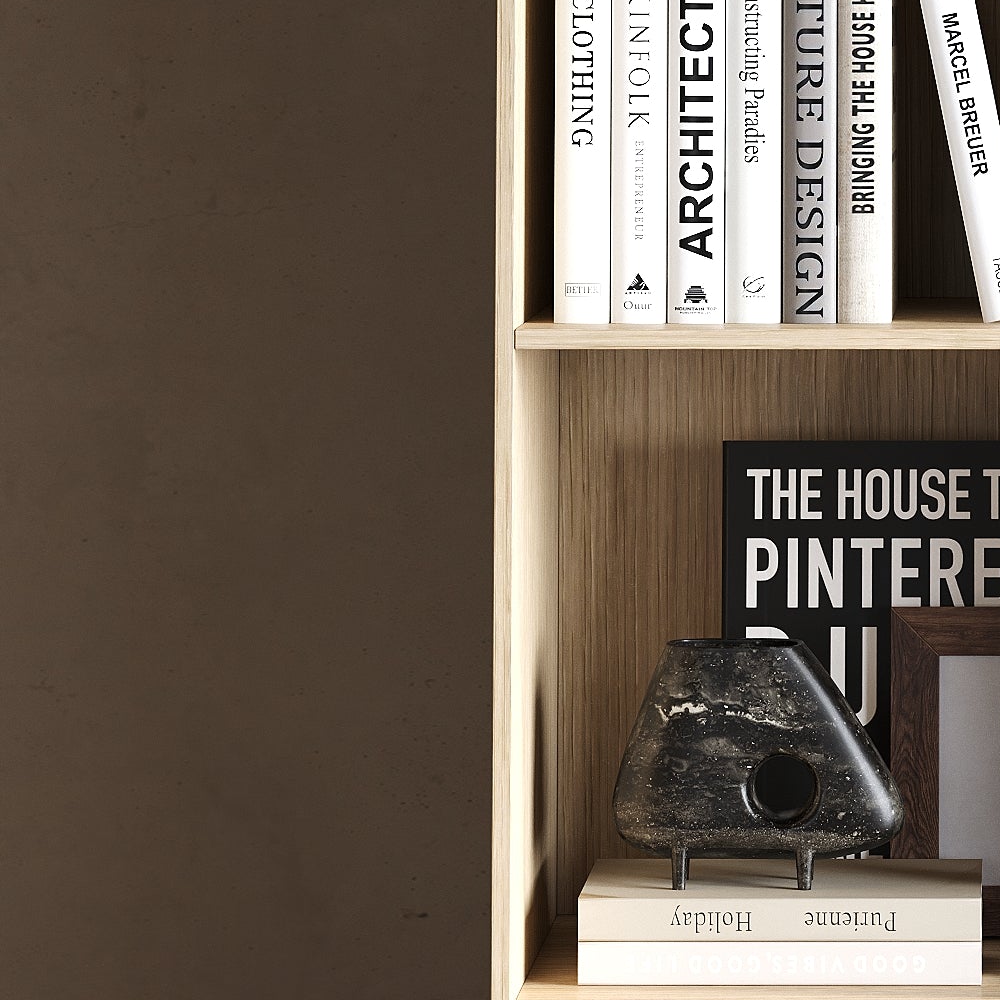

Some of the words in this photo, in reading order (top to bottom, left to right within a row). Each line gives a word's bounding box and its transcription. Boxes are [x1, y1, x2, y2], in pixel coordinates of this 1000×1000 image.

[851, 11, 875, 74] HOUSE
[743, 87, 766, 164] Paradies
[851, 80, 875, 117] THE
[941, 12, 971, 94] MARCEL
[958, 96, 989, 178] BREUER
[634, 140, 644, 241] ENTREPRENEUR
[851, 123, 875, 214] BRINGING
[792, 138, 825, 318] DESIGN
[746, 468, 823, 520] THE
[837, 468, 971, 520] HOUSE
[670, 904, 753, 934] Holiday
[804, 911, 897, 932] Purienne
